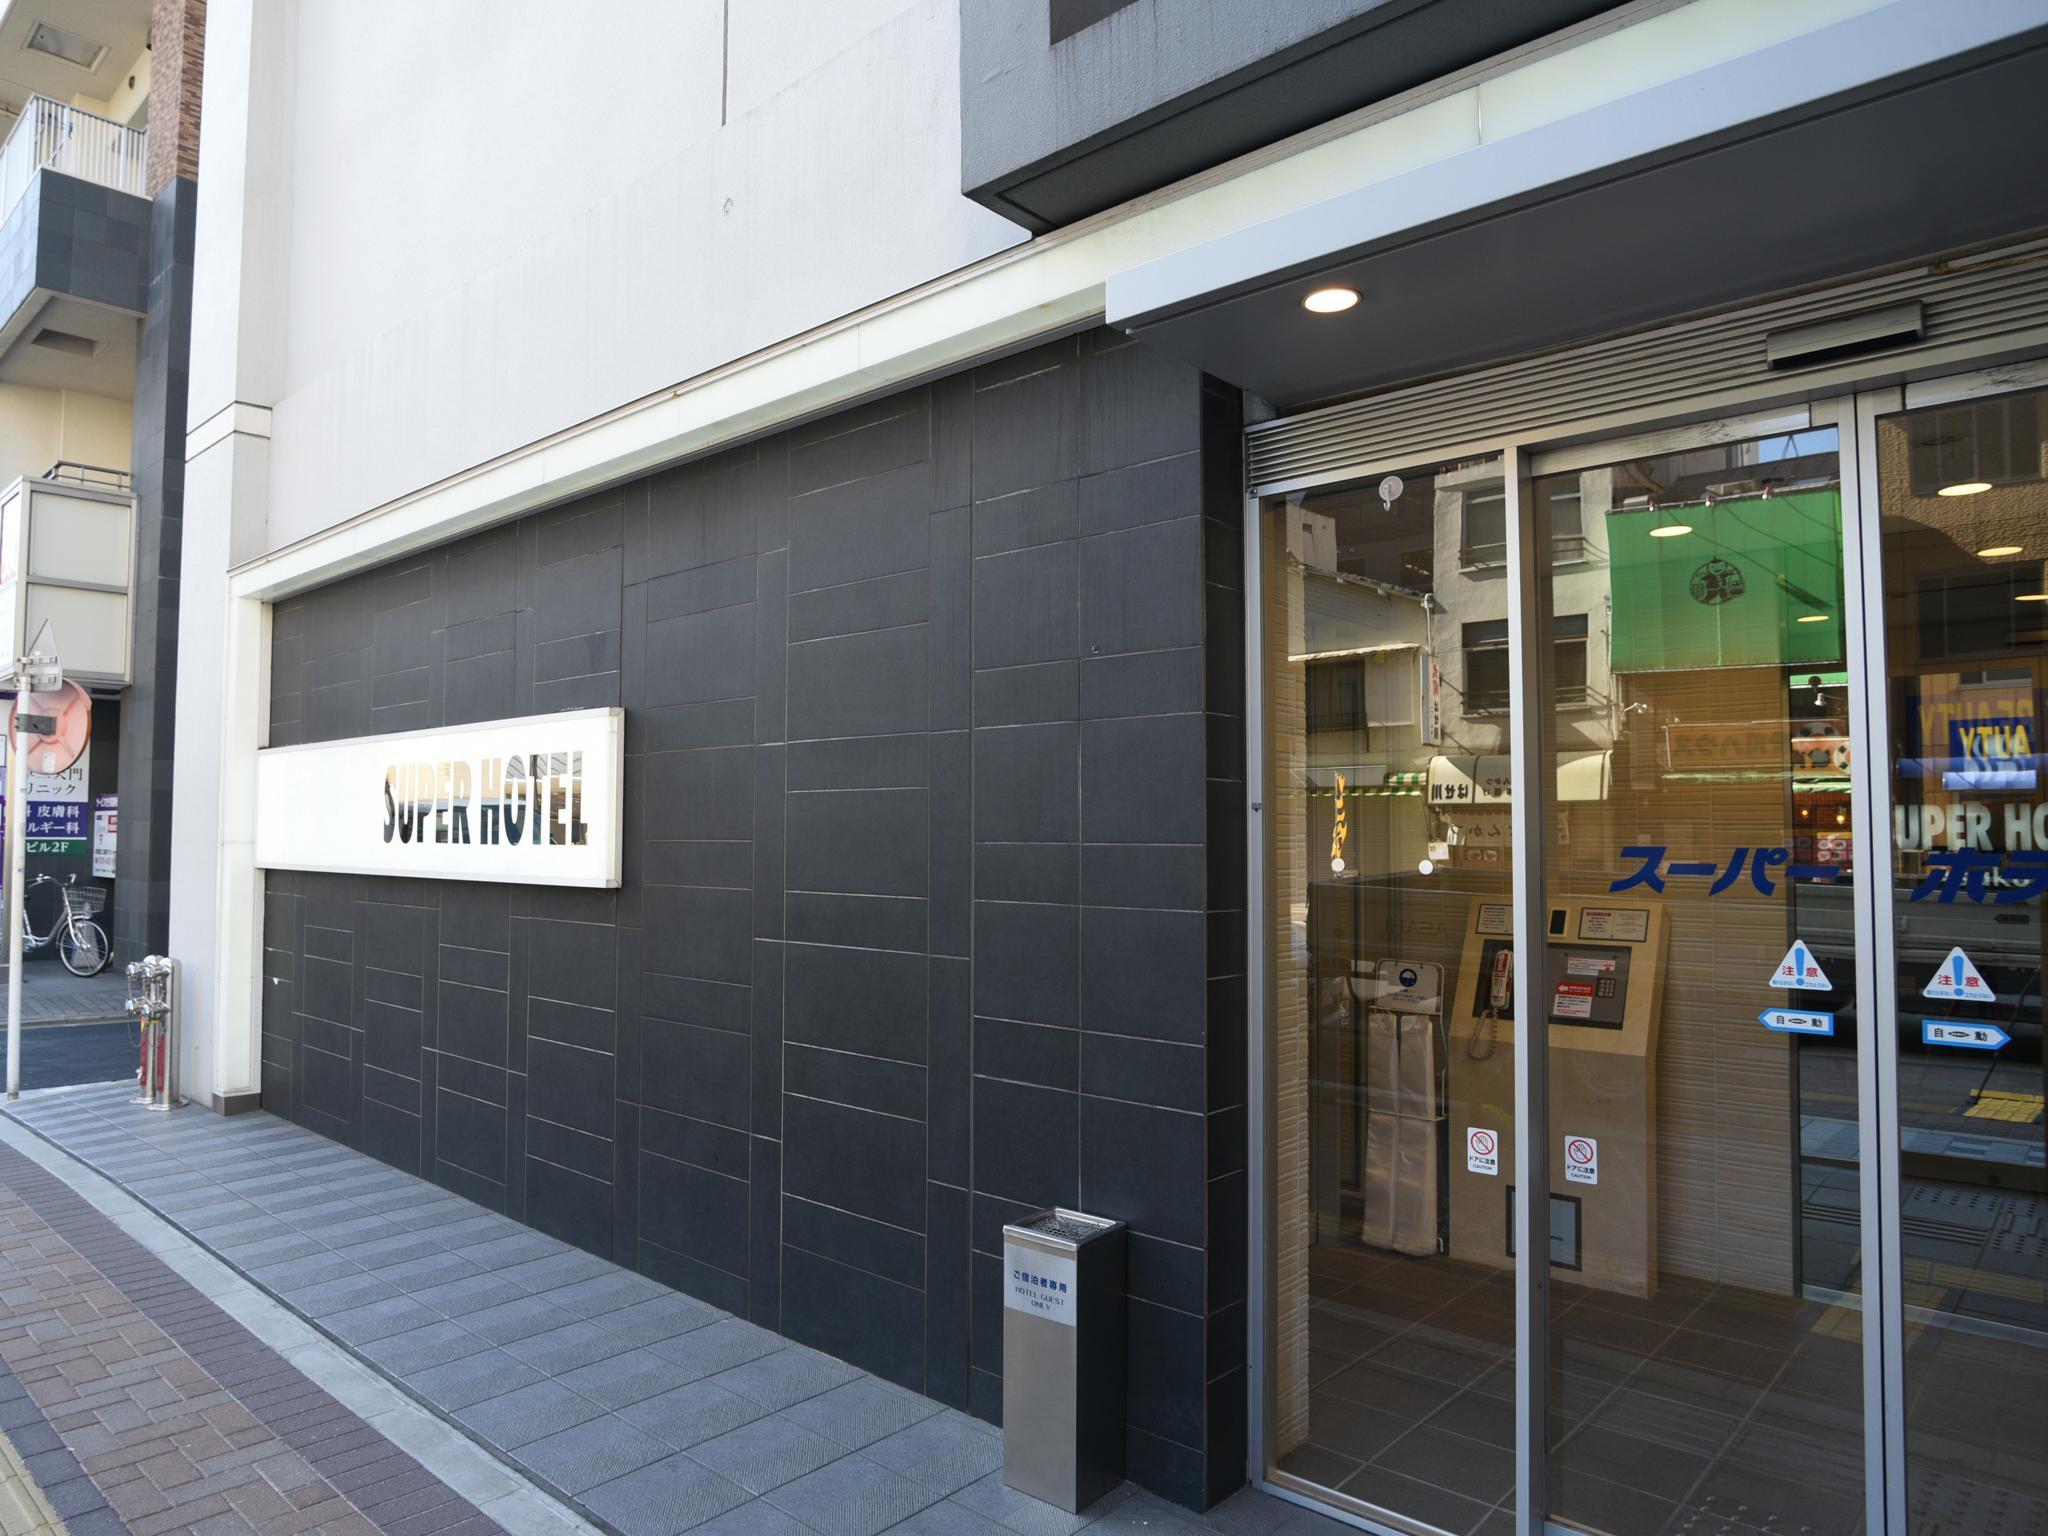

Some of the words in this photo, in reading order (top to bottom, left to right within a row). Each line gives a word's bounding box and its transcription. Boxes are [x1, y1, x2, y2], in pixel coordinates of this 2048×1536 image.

[383, 761, 472, 844] SUPER
[480, 750, 589, 846] HOTEL
[1609, 846, 1842, 897] スーパー
[1469, 1155, 1496, 1166] ドアに注意
[1473, 1163, 1493, 1171] CAUTION
[1567, 1164, 1595, 1175] ドアに注意
[1571, 1172, 1592, 1180] CAUTION
[1014, 1270, 1067, 1293] ご宿泊者専用
[1015, 1285, 1038, 1299] HOTEL
[1041, 1293, 1065, 1307] GUEST
[1031, 1300, 1051, 1311] ONLY
